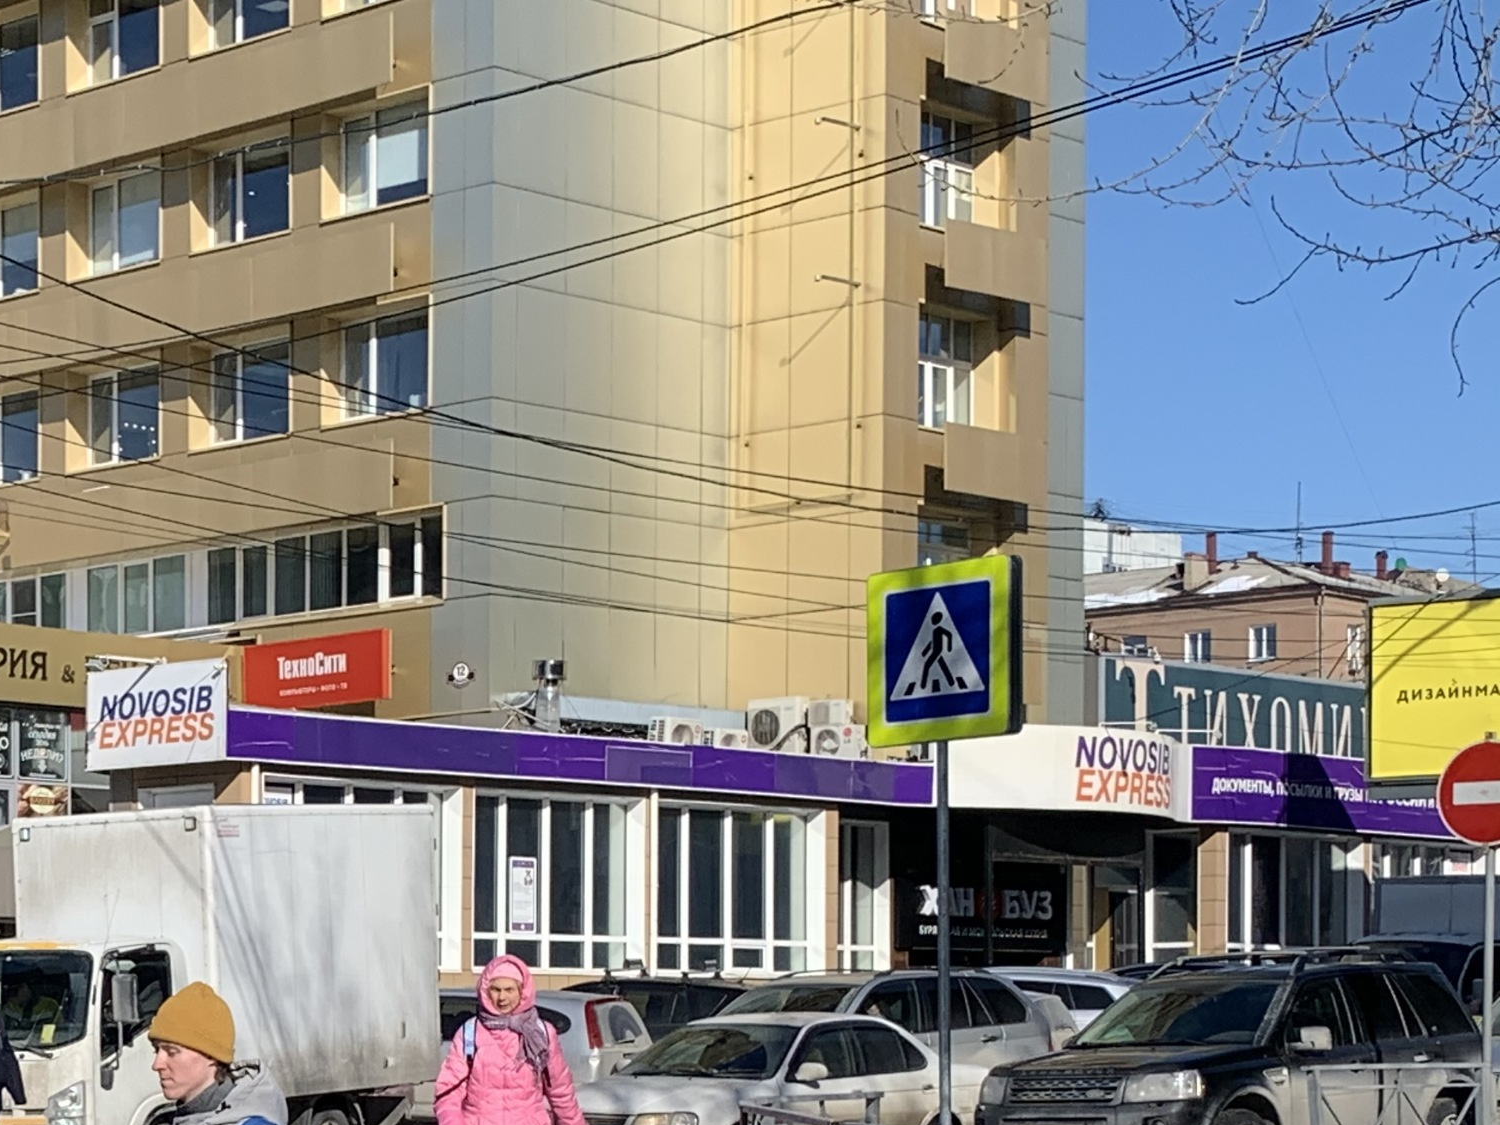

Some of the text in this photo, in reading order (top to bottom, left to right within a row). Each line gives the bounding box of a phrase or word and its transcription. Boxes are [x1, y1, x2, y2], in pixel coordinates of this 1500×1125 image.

[277, 651, 347, 680] ТехноСити
[100, 685, 213, 721] NOVOSIB
[98, 712, 214, 749] EXPRESS
[1075, 736, 1170, 773] NOVOSIB
[1075, 769, 1171, 809] EXPRESS
